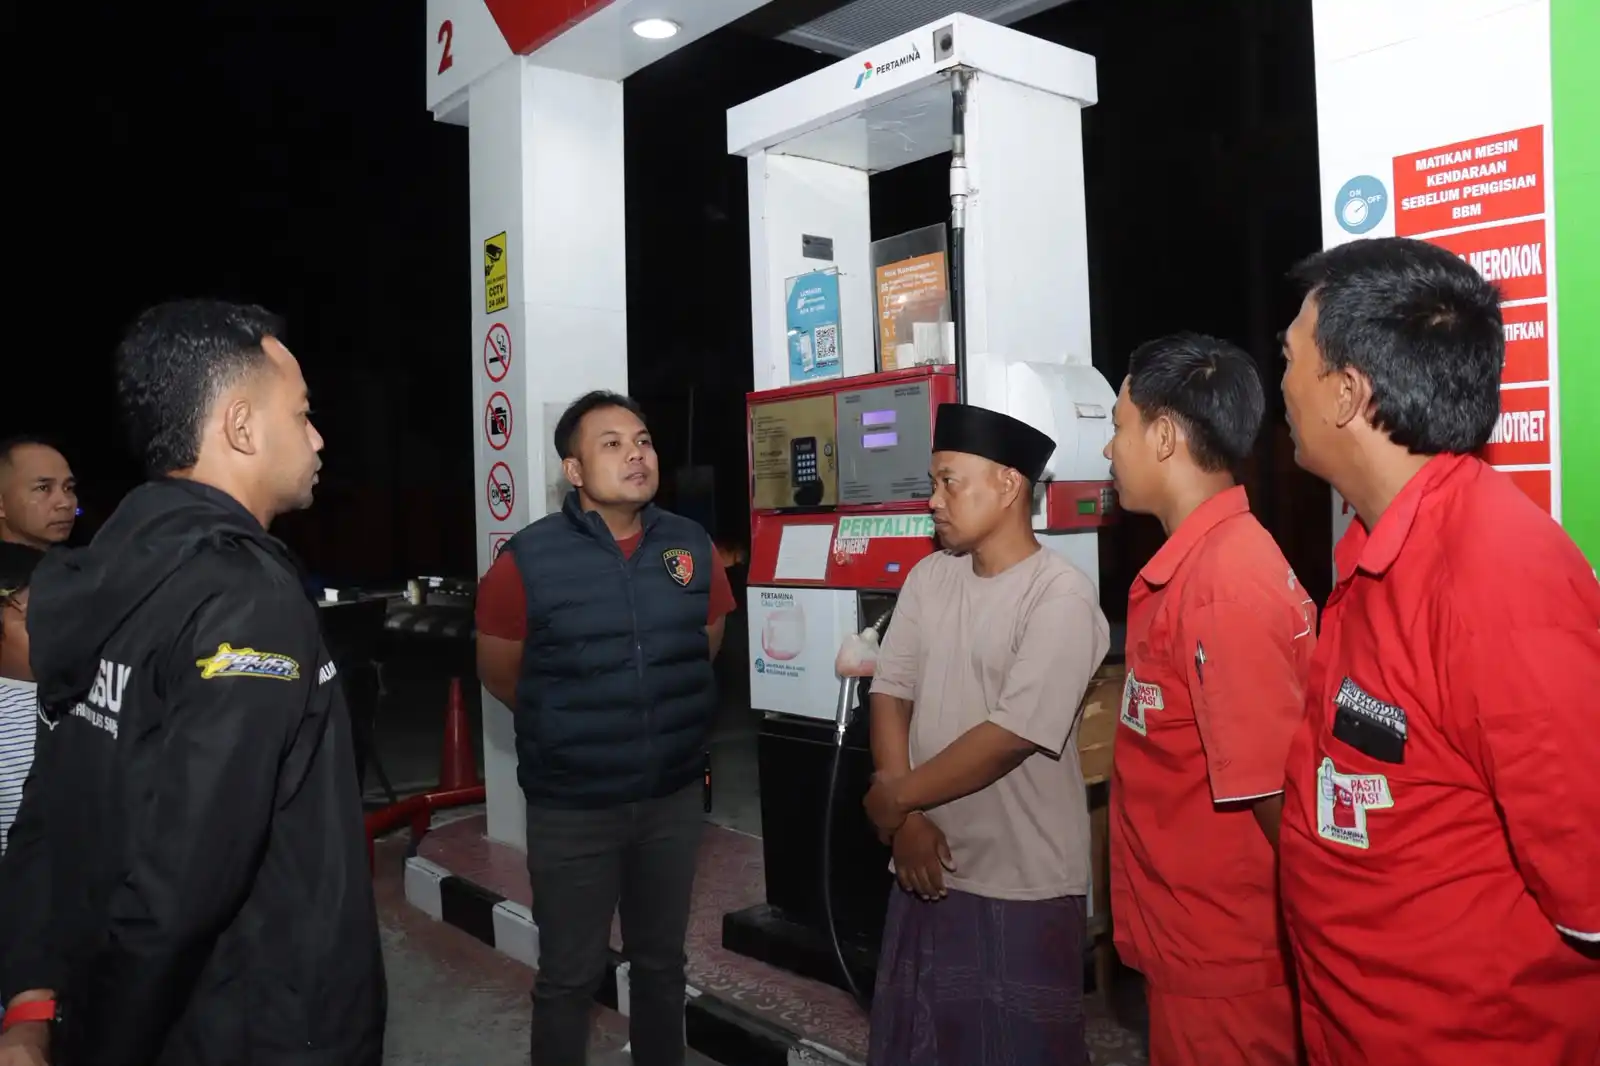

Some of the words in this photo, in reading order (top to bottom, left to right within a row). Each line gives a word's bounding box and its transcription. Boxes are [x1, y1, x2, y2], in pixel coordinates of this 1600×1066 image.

[437, 19, 453, 75] 2
[876, 50, 921, 75] PERTAMINA
[1415, 149, 1472, 172] MATIKAN
[1474, 138, 1519, 159] MESIN
[1426, 160, 1507, 187] KENDARAAN
[1349, 189, 1362, 198] ON
[1367, 194, 1382, 204] OFF
[1401, 189, 1460, 211] SEBELUM
[1463, 174, 1537, 199] PENGISIAN
[1452, 203, 1482, 220] BBM
[1469, 243, 1543, 282] MEROKOK
[1504, 320, 1545, 342] TIFKAN
[1486, 410, 1546, 444] MOTRET
[840, 516, 935, 537] PERTALITE
[760, 592, 794, 601] PERTAMINA
[1350, 779, 1382, 794] PASTI
